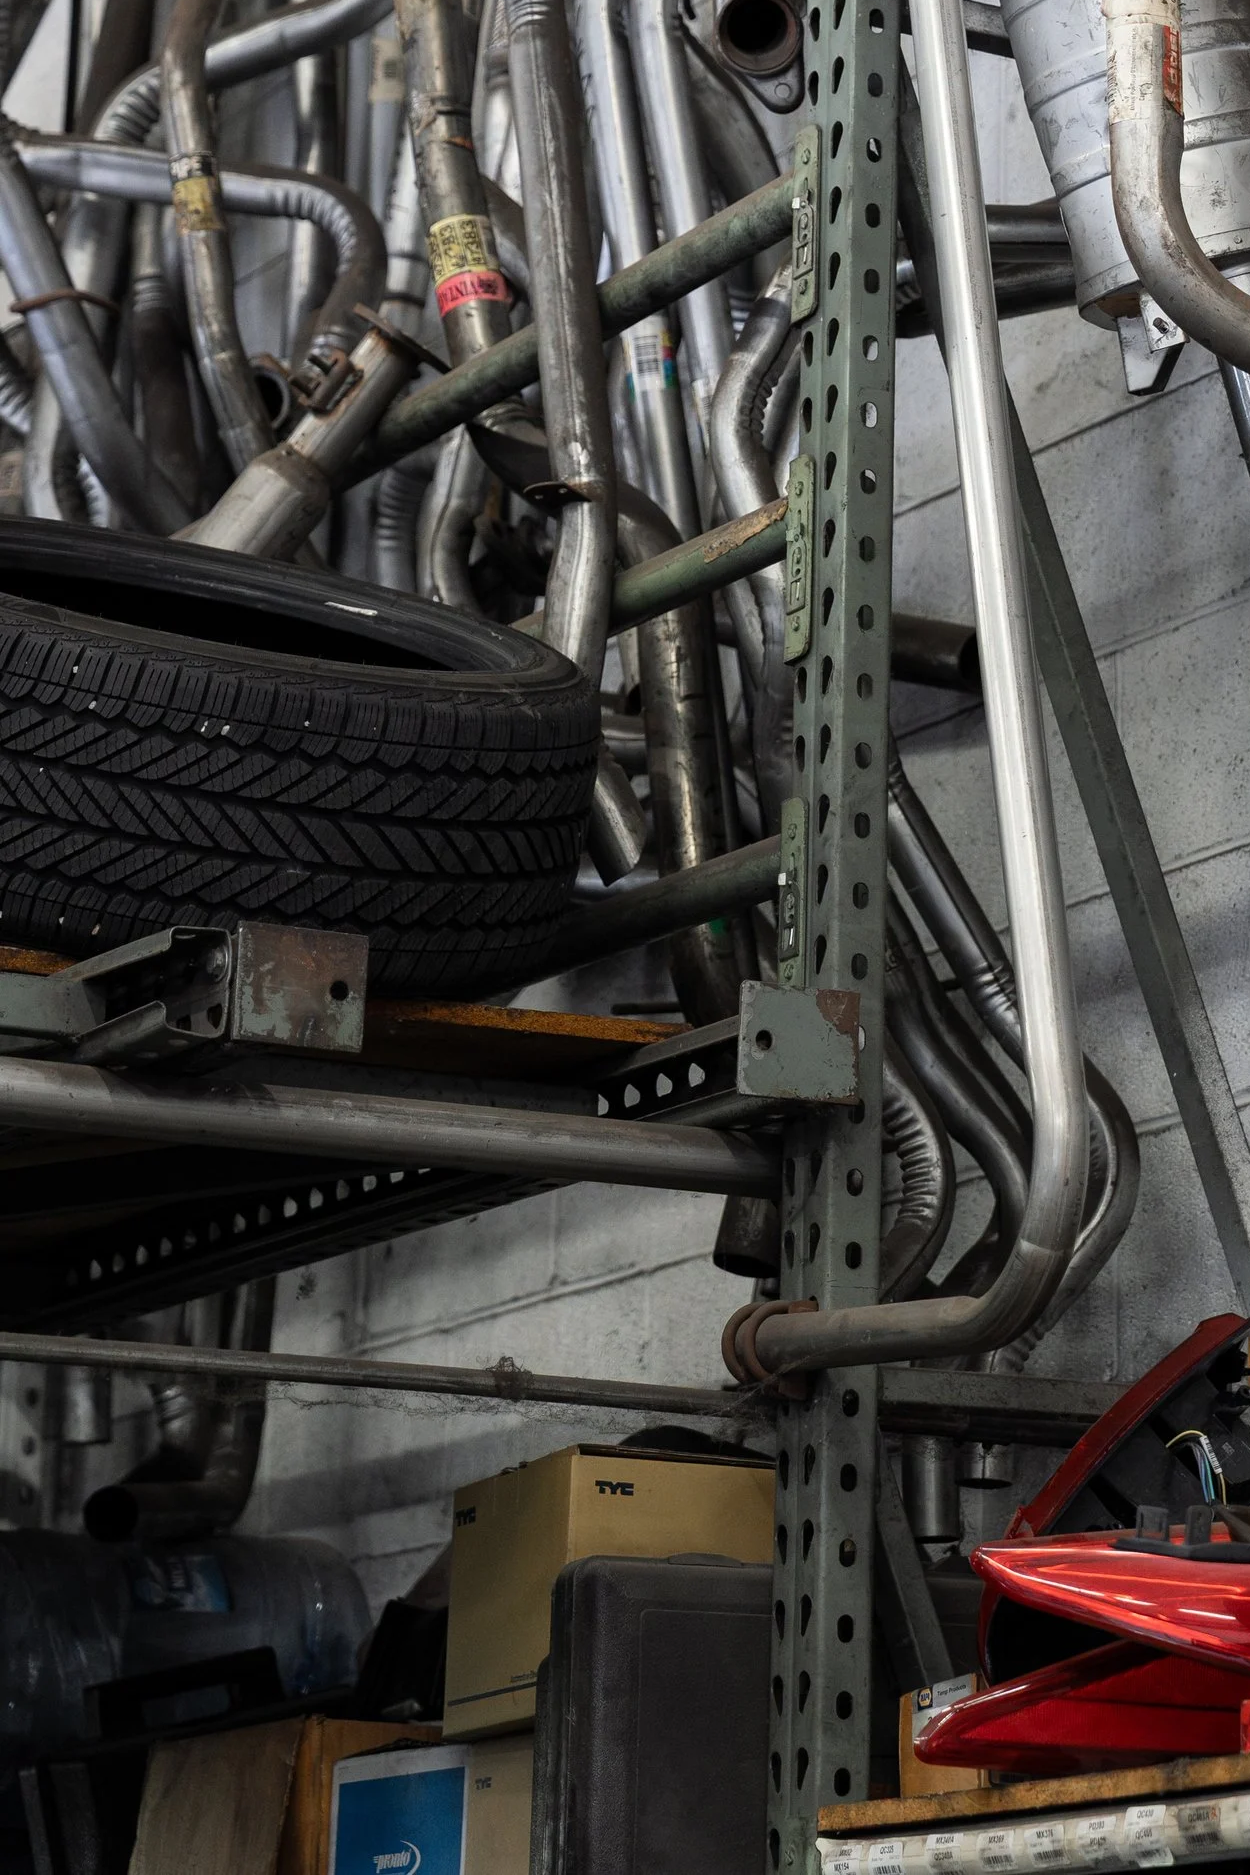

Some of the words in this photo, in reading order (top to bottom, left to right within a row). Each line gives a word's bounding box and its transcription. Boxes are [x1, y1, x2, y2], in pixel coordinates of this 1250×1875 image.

[594, 1479, 635, 1496] TYC
[455, 1506, 477, 1527] TYC
[375, 1849, 412, 1874] pronto
